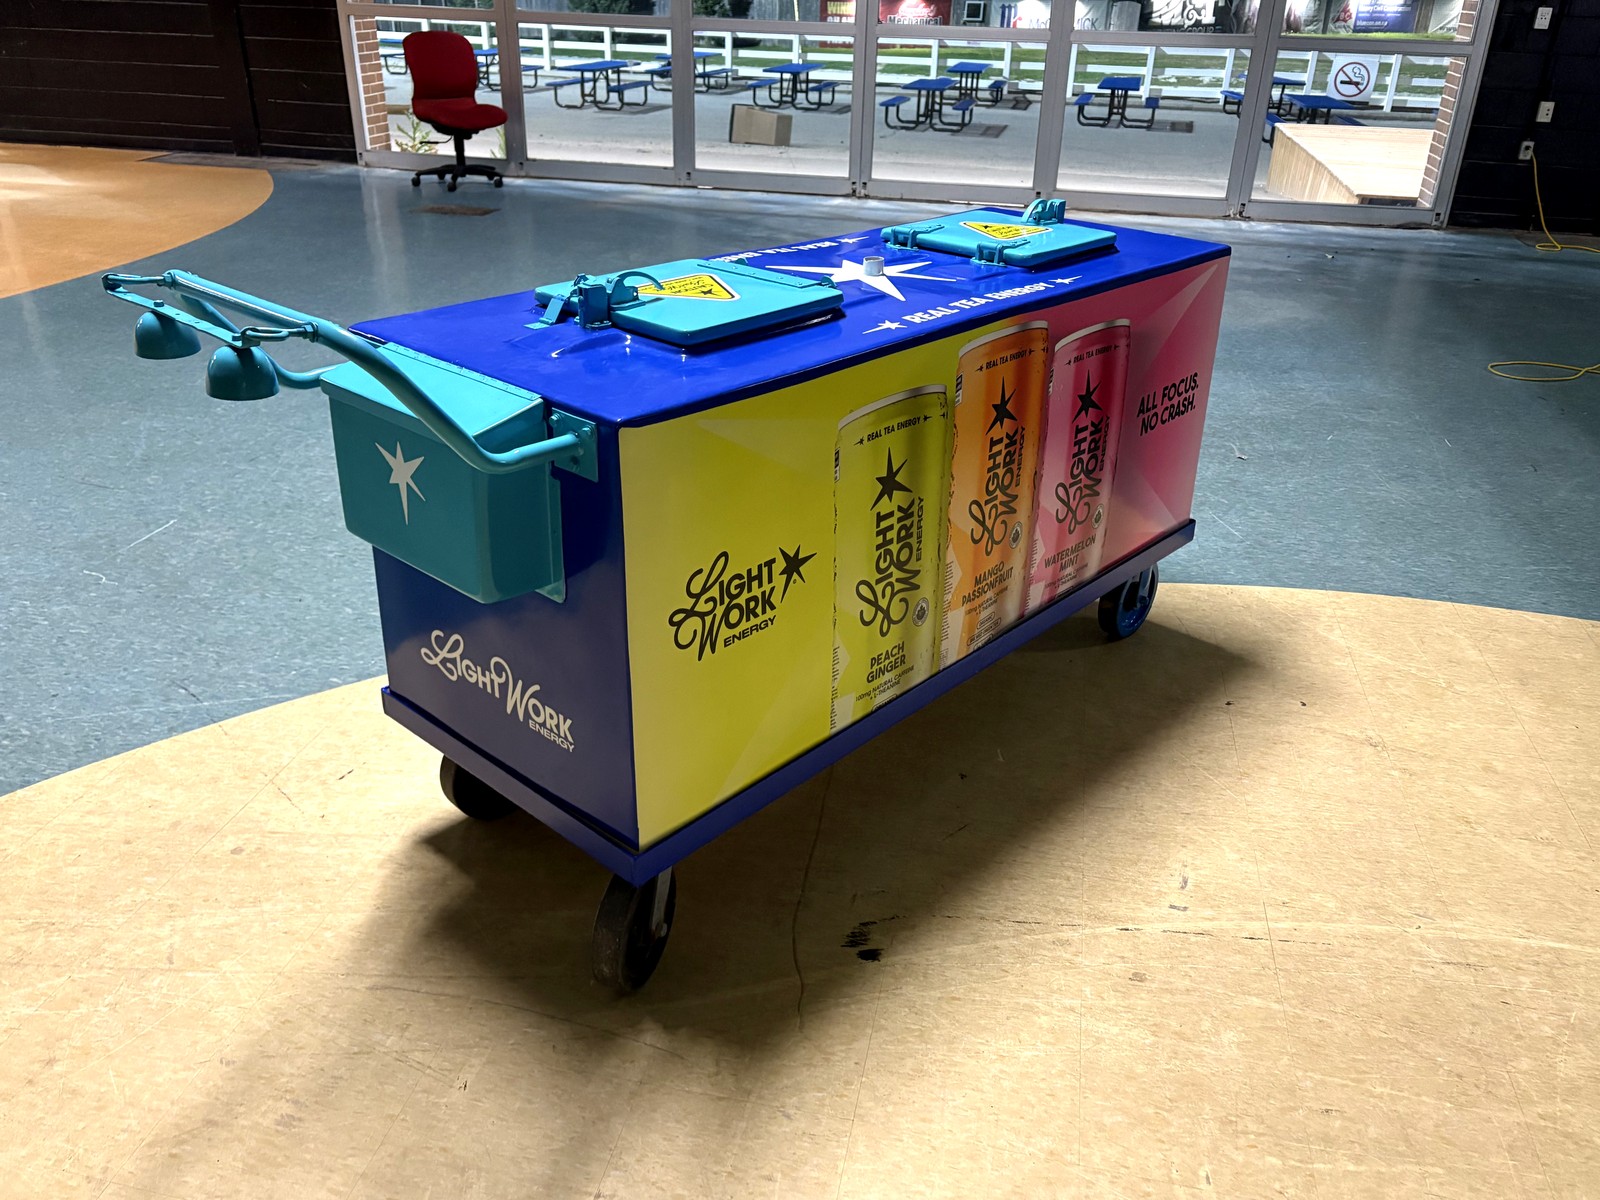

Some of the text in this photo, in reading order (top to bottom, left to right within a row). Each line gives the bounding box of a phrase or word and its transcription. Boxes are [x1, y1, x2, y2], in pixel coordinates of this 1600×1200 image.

[902, 282, 1055, 324] REAL TEA ENERGY
[985, 350, 1028, 370] REAL TEA ENERGY
[1073, 345, 1113, 365] REAL TEA ENERGY
[1137, 372, 1198, 418] ALL FOCUS.
[1140, 393, 1196, 437] NO CRASH.
[867, 416, 921, 443] REAL TEA ENERGY
[1099, 415, 1110, 473] ENERGY
[1015, 426, 1026, 488] ENERGY
[1074, 418, 1104, 525] WORK
[968, 437, 1004, 557] LIGHT
[992, 427, 1019, 546] WORK
[1055, 424, 1089, 535] LIGHT
[916, 496, 925, 562] ENERGY
[1044, 533, 1096, 569] WATERMELON
[855, 510, 895, 638] LIGHT
[888, 498, 921, 625] WORK
[974, 560, 1005, 587] MANGO
[1059, 554, 1079, 573] MINT
[668, 551, 777, 628] LIGHT
[962, 566, 1013, 607] PASSIONFRUIT
[674, 586, 777, 662] WORK
[723, 615, 777, 648] ENERGY
[866, 654, 906, 684] GINGER
[870, 641, 905, 670] PEACH
[421, 629, 574, 743] LIGHT WORK
[855, 690, 872, 702] 100mg
[872, 677, 893, 694] NATURAL
[529, 719, 575, 752] ENERGY
